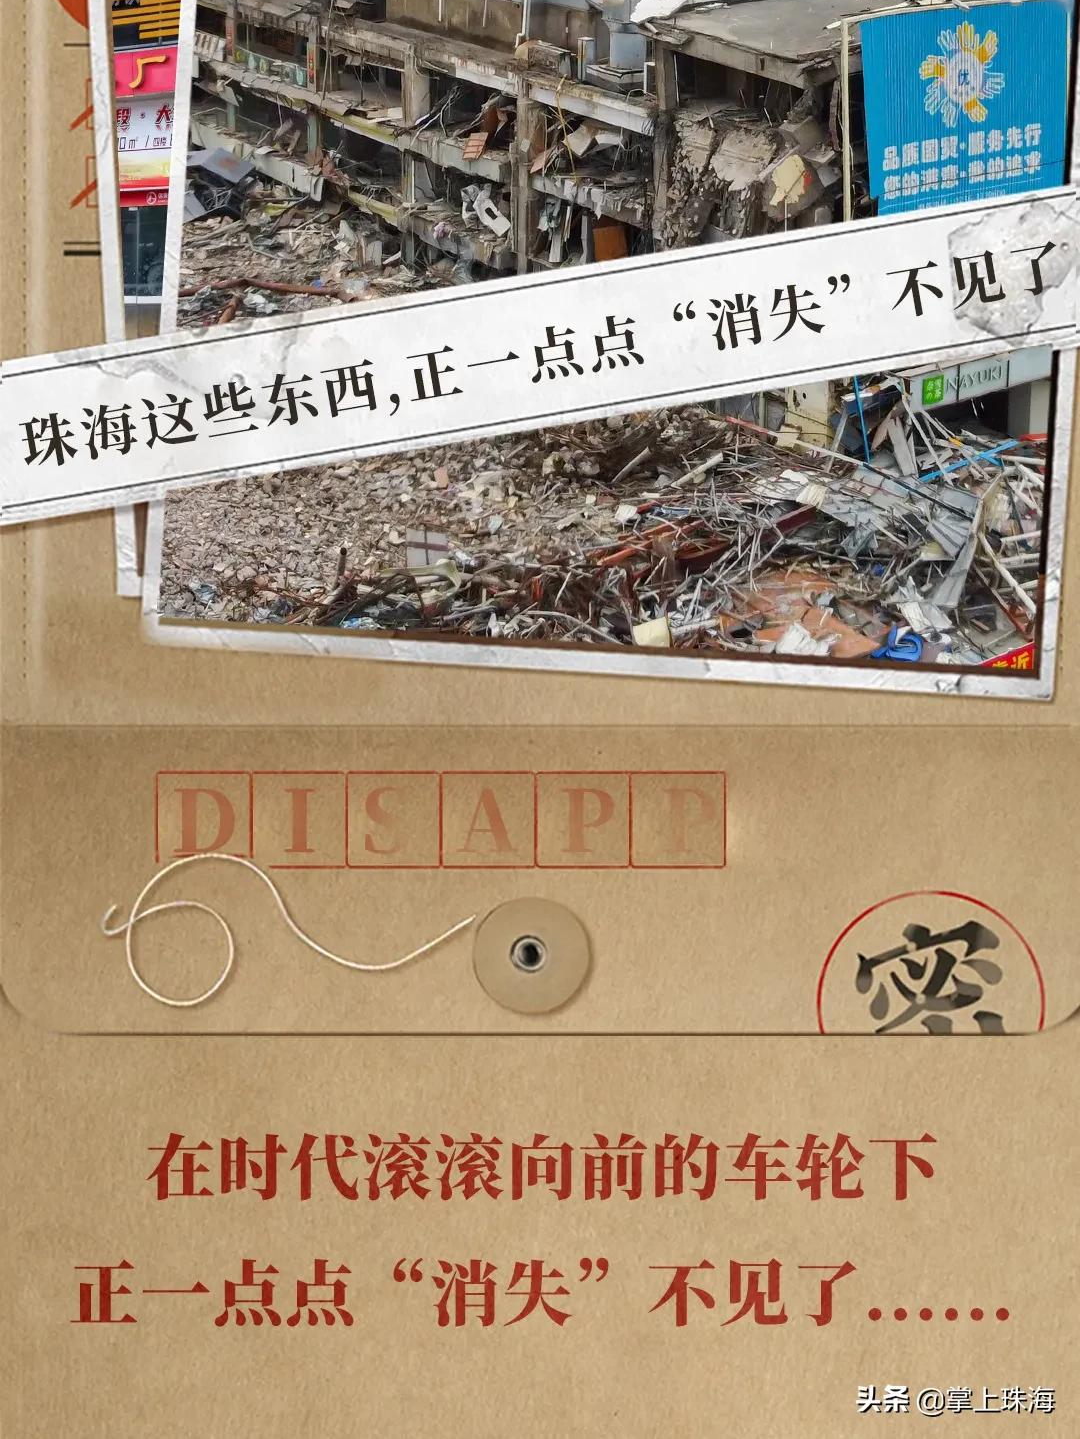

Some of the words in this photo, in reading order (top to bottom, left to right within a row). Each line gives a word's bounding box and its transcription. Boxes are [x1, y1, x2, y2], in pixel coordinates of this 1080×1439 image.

[946, 365, 1002, 394] NAYUKI
[146, 1132, 937, 1202] 在时代滚滚向前的车轮下
